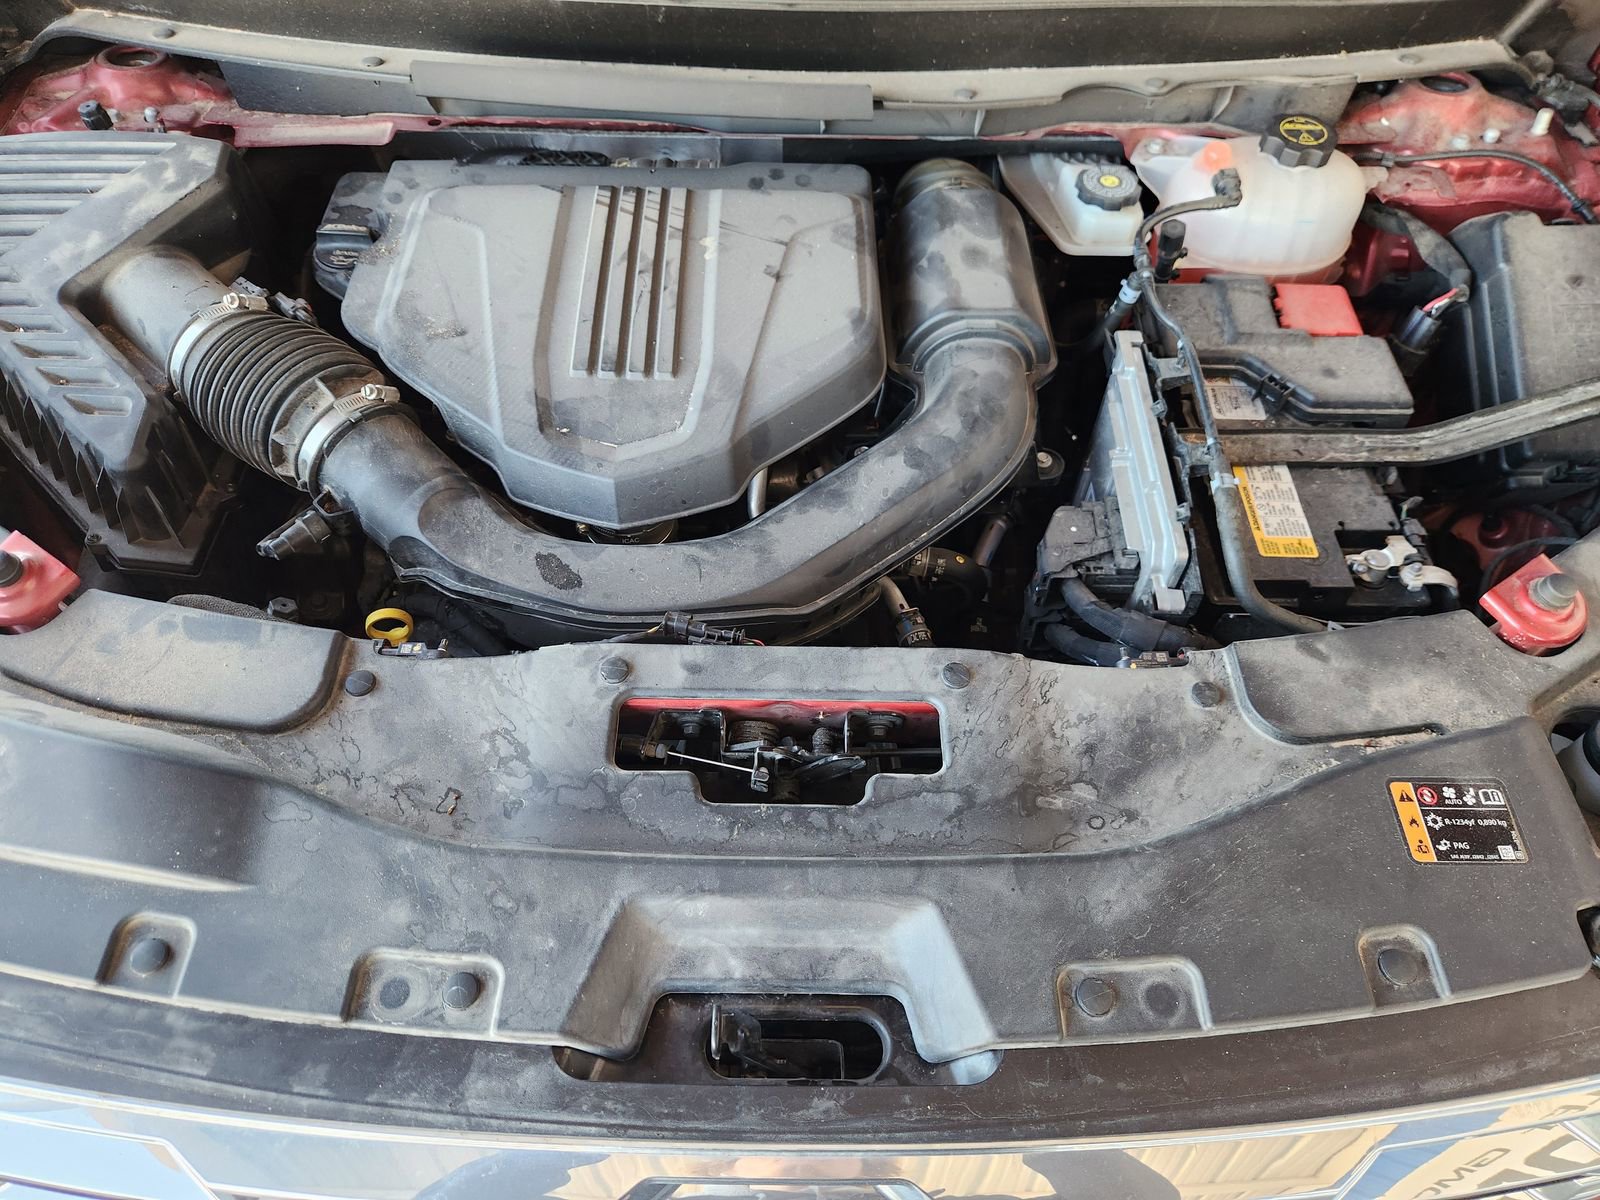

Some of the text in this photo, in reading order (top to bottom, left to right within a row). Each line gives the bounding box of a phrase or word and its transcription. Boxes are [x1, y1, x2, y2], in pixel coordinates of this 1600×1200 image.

[1444, 818, 1476, 827] R-1234yf
[1497, 819, 1508, 828] kg
[1453, 841, 1470, 850] PAG
